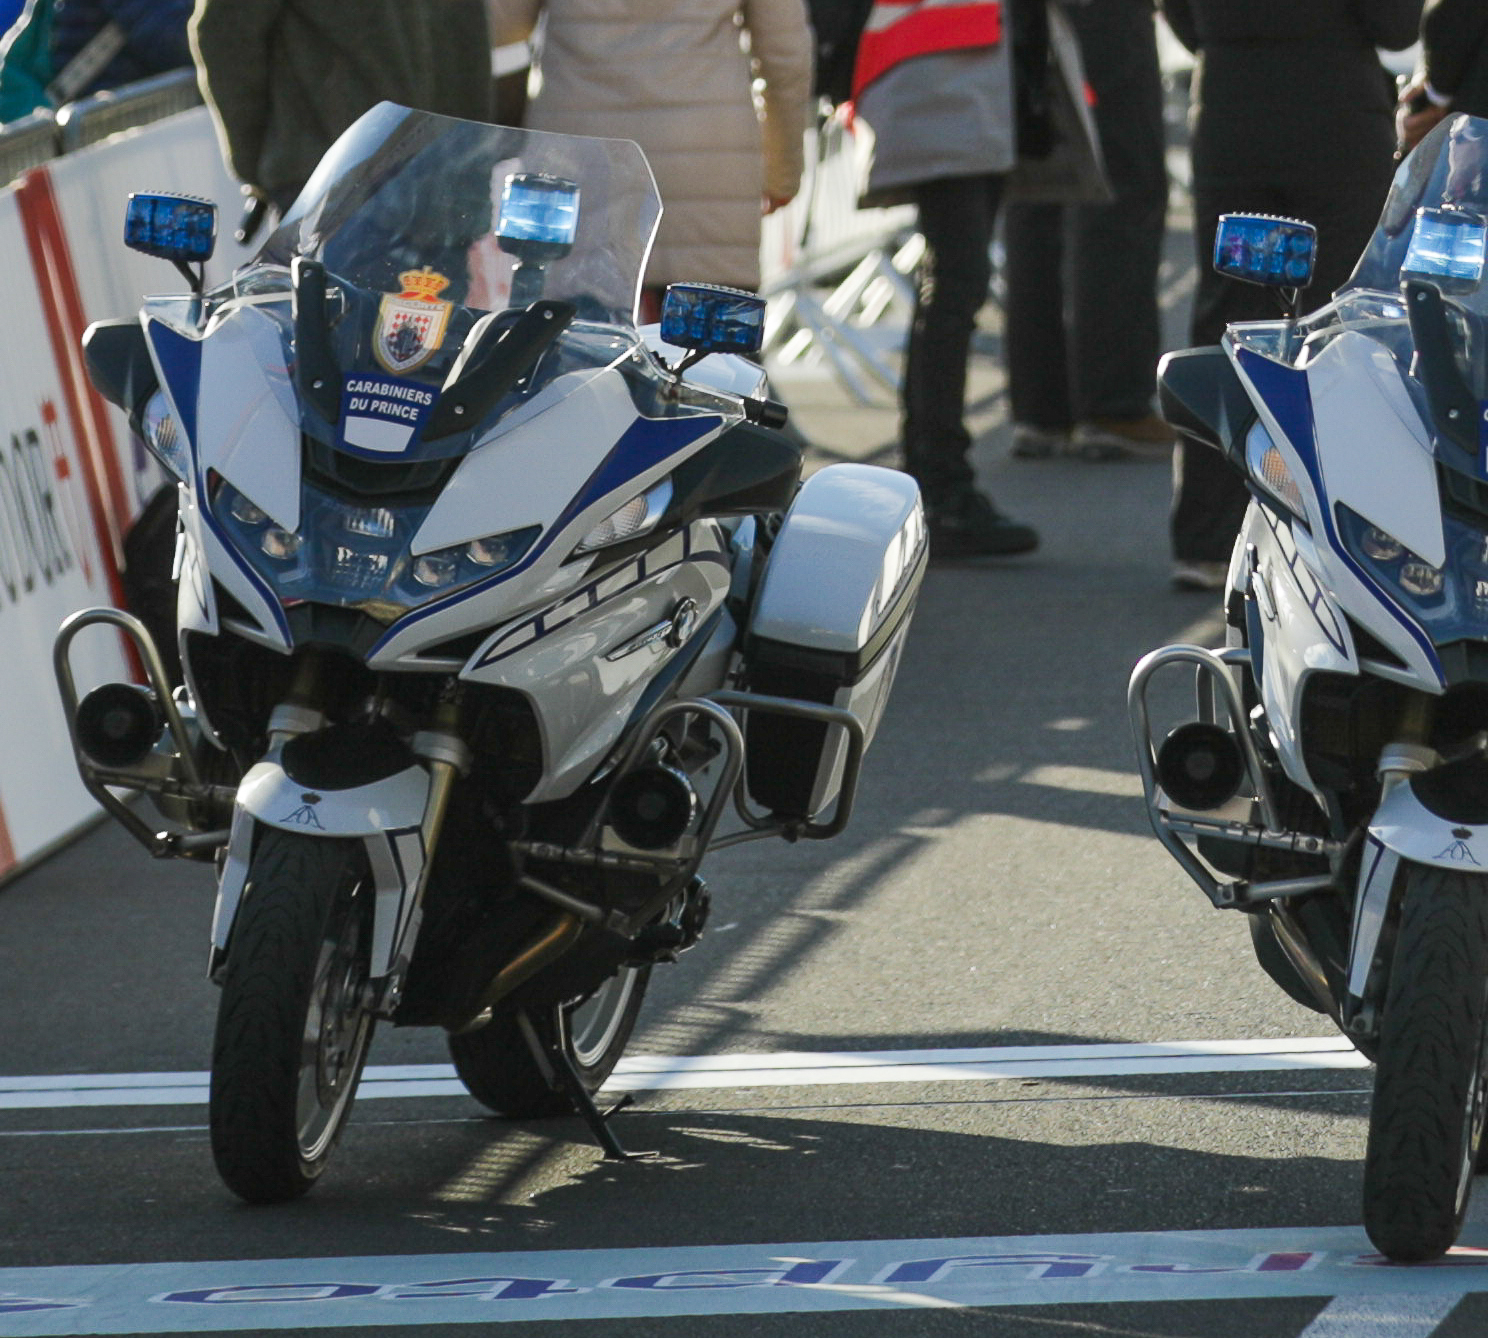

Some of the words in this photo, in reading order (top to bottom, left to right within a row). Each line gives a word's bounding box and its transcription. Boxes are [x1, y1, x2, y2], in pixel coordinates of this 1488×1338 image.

[346, 379, 433, 405] CARABINIERS
[349, 397, 369, 410] DU
[370, 401, 420, 421] PRINCE
